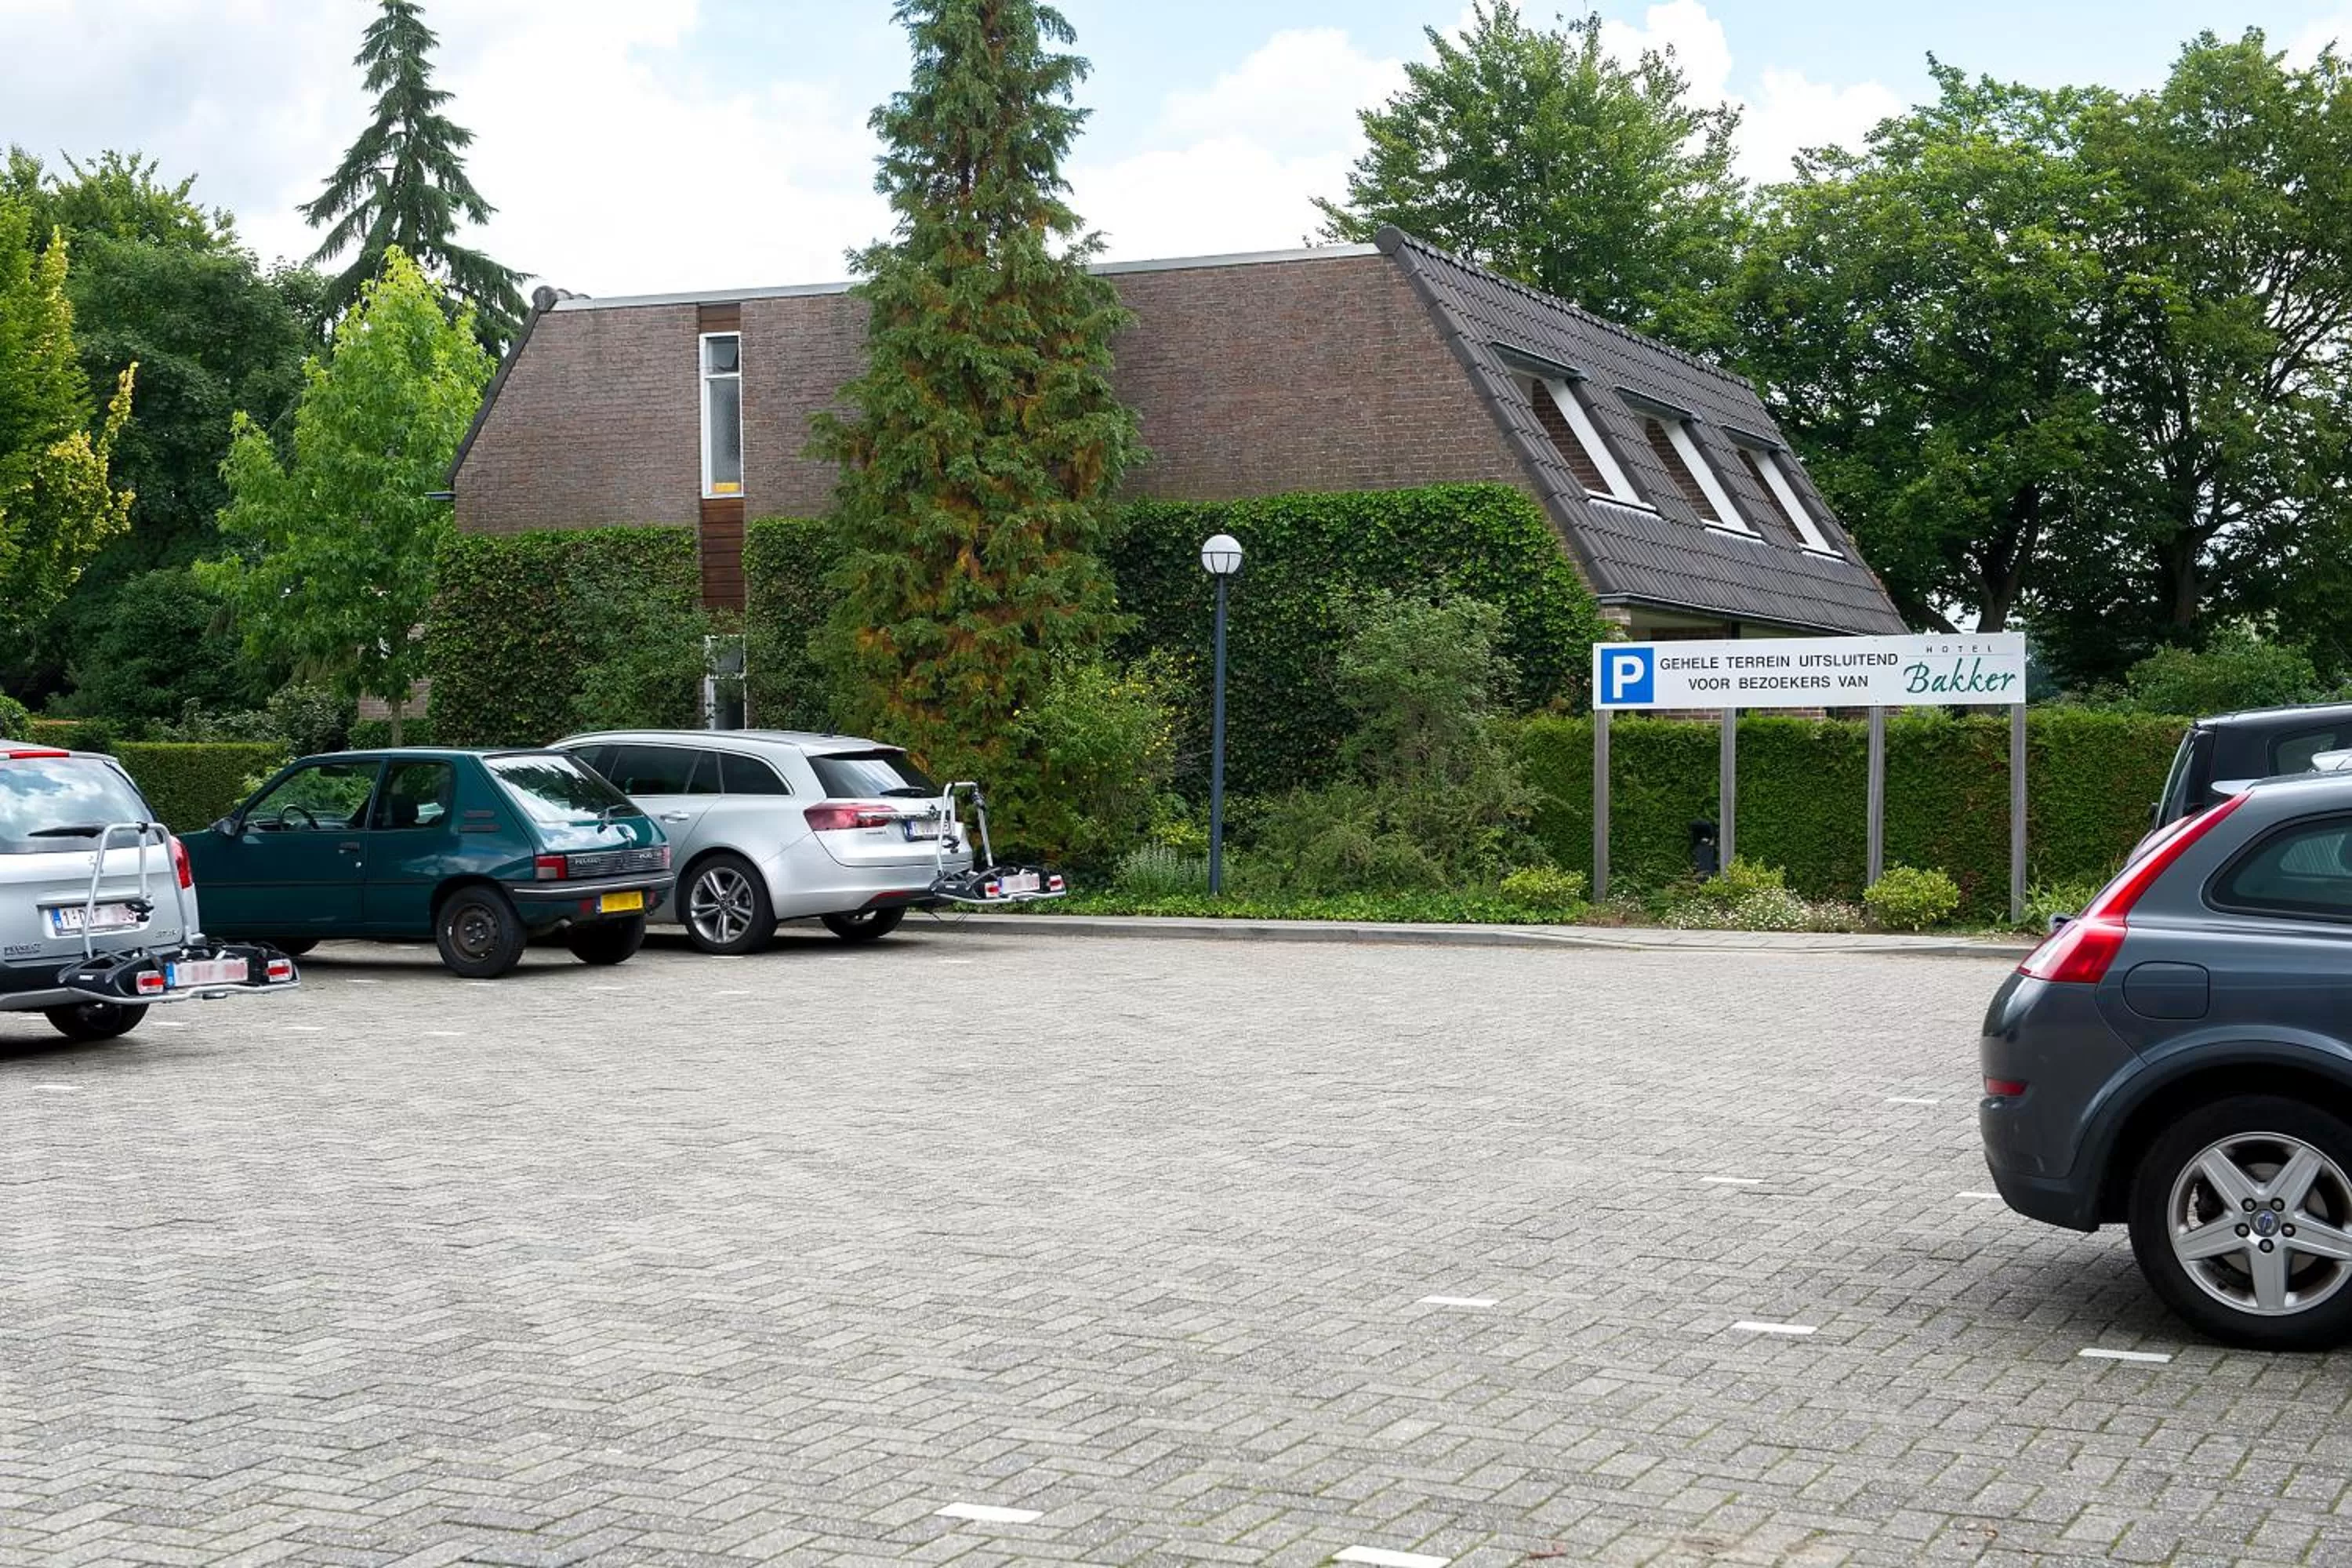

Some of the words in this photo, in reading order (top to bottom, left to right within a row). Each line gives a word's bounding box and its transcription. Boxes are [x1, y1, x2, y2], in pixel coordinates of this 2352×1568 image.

[1926, 645, 1992, 654] HOTEL
[1660, 657, 1719, 670] GEHELE
[1726, 655, 1790, 669] TERREIN
[1799, 653, 1898, 667] UITSLUITEND
[1613, 655, 1645, 699] P
[1688, 677, 1730, 691] VOOR
[1738, 676, 1831, 689] BEZOEKERS
[1838, 675, 1868, 688] VAN
[1903, 657, 2017, 694] Bakker
